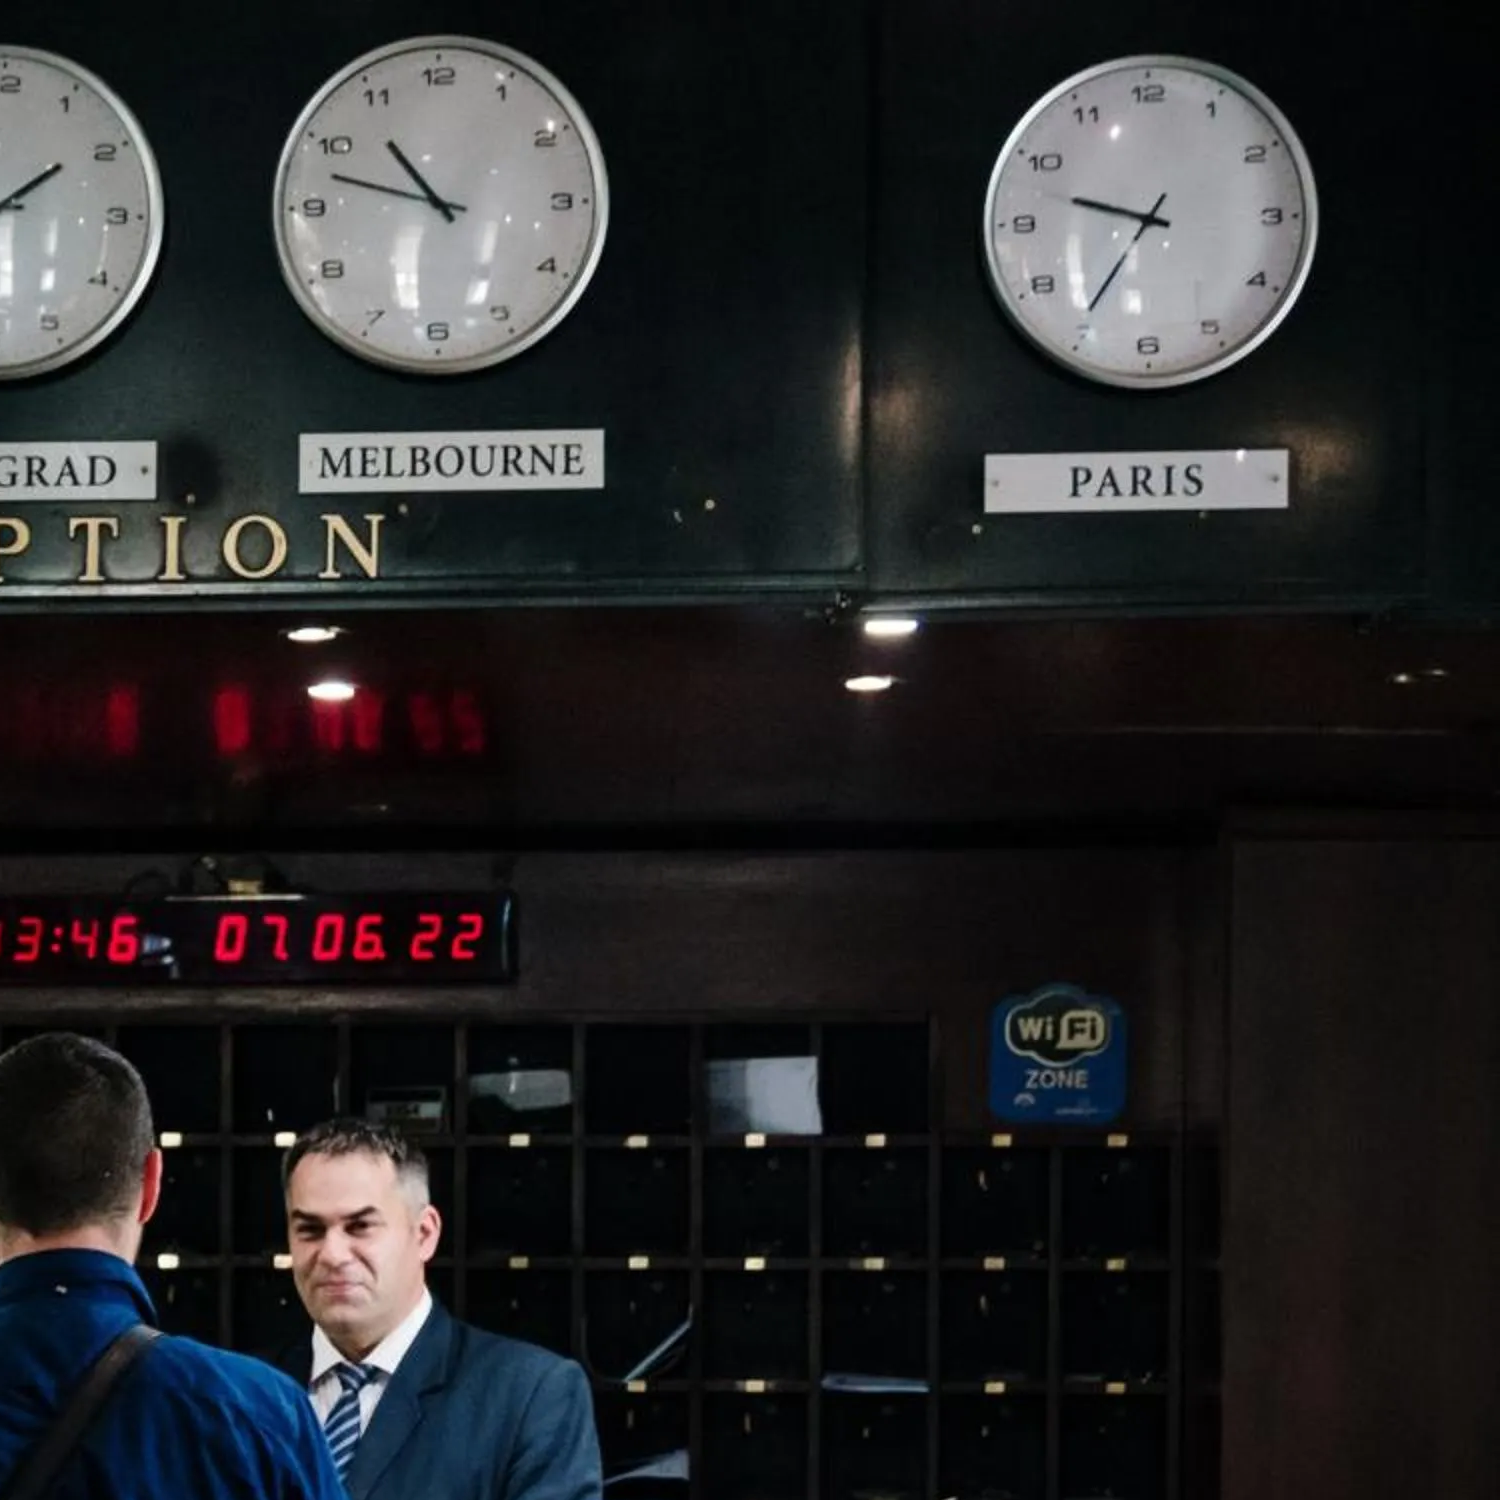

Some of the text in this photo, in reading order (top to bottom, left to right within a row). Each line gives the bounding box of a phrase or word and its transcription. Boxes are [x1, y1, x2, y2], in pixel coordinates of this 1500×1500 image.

[422, 68, 455, 85] 12
[363, 89, 389, 106] 11
[496, 85, 507, 100] 1
[1131, 85, 1165, 103] 12
[60, 96, 70, 113] 1
[1206, 102, 1216, 118] 1
[1073, 106, 1099, 122] 11
[319, 136, 352, 154] 10
[534, 130, 557, 147] 2
[94, 144, 116, 161] 2
[1244, 146, 1266, 163] 2
[1029, 154, 1062, 171] 10
[304, 199, 326, 217] 9
[550, 193, 573, 211] 3
[106, 208, 128, 224] 3
[1013, 215, 1035, 233] 9
[1260, 209, 1283, 225] 3
[321, 260, 344, 278] 8
[537, 257, 556, 274] 4
[88, 271, 108, 286] 4
[1031, 275, 1054, 293] 8
[1246, 271, 1266, 287] 4
[41, 315, 59, 330] 5
[366, 309, 385, 323] 7
[427, 323, 449, 341] 6
[1202, 320, 1220, 334] 5
[1137, 337, 1159, 355] 6
[318, 444, 585, 479] MELBOURNE
[1069, 464, 1204, 497] PARIS
[1024, 1069, 1089, 1089] ZONE
